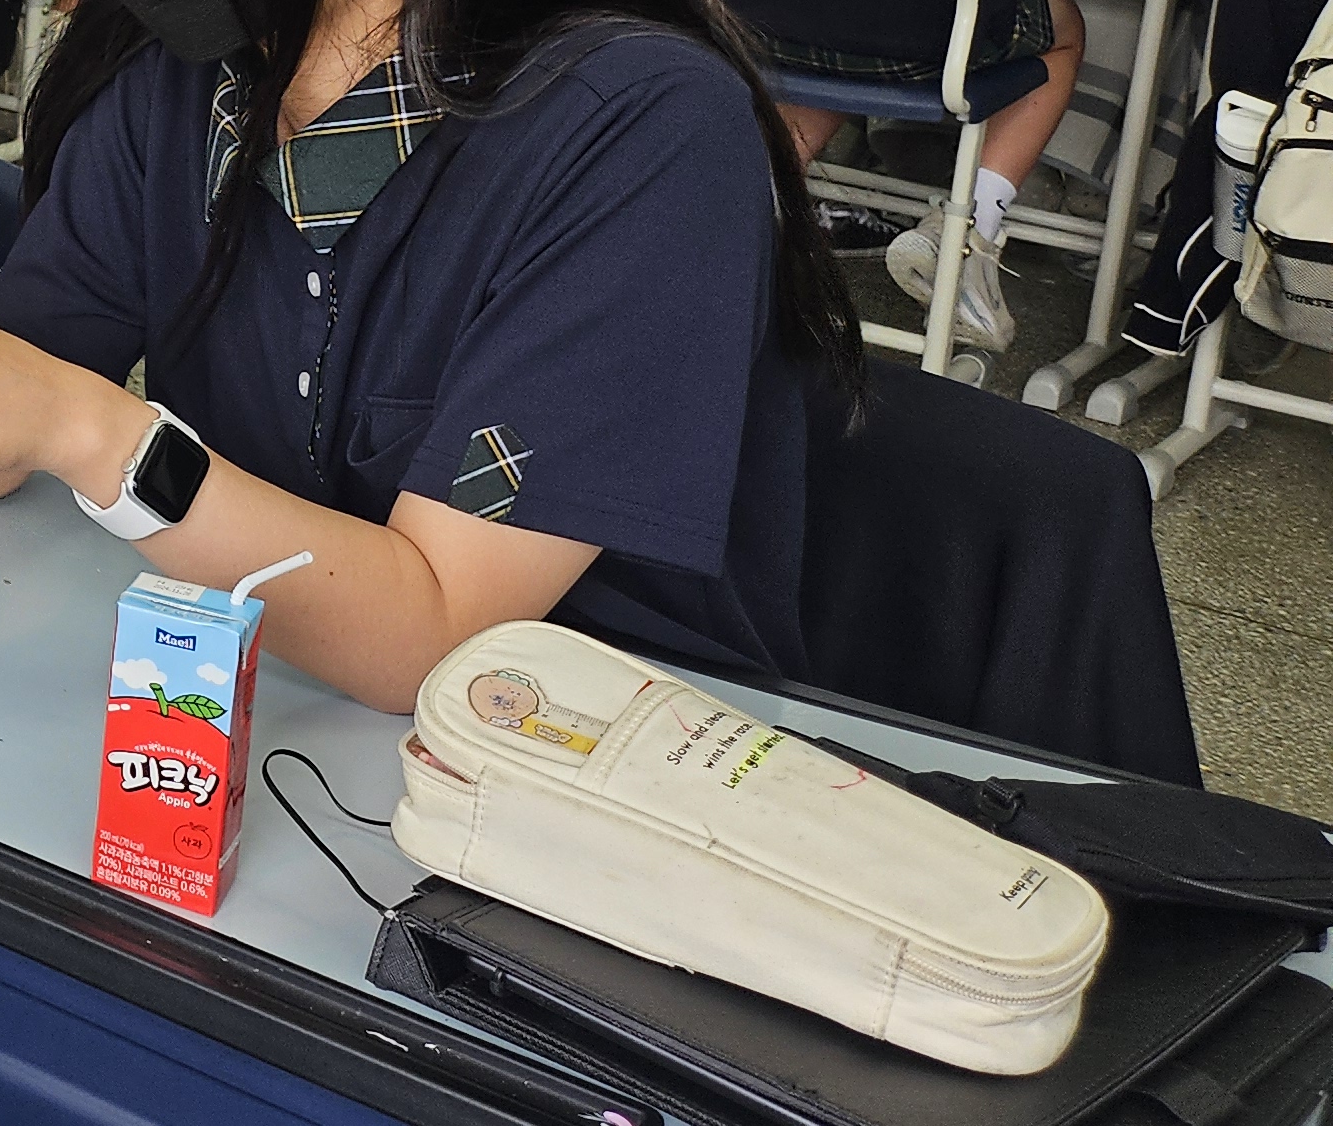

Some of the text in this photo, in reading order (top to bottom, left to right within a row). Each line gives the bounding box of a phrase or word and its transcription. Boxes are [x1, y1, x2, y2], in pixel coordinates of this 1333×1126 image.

[157, 632, 194, 649] Maeil
[666, 740, 693, 765] Slow
[689, 722, 709, 742] and
[703, 749, 726, 769] wins
[717, 735, 738, 750] the
[107, 750, 218, 805] 피크닉
[721, 766, 749, 790] Let's
[744, 749, 763, 769] get
[158, 792, 191, 809] Apple
[181, 836, 203, 850] 사과
[98, 841, 160, 872] 사과과즙농축액
[126, 863, 180, 889] 사과페이스트
[149, 882, 182, 902] 0.09%
[998, 880, 1029, 902] Keep
